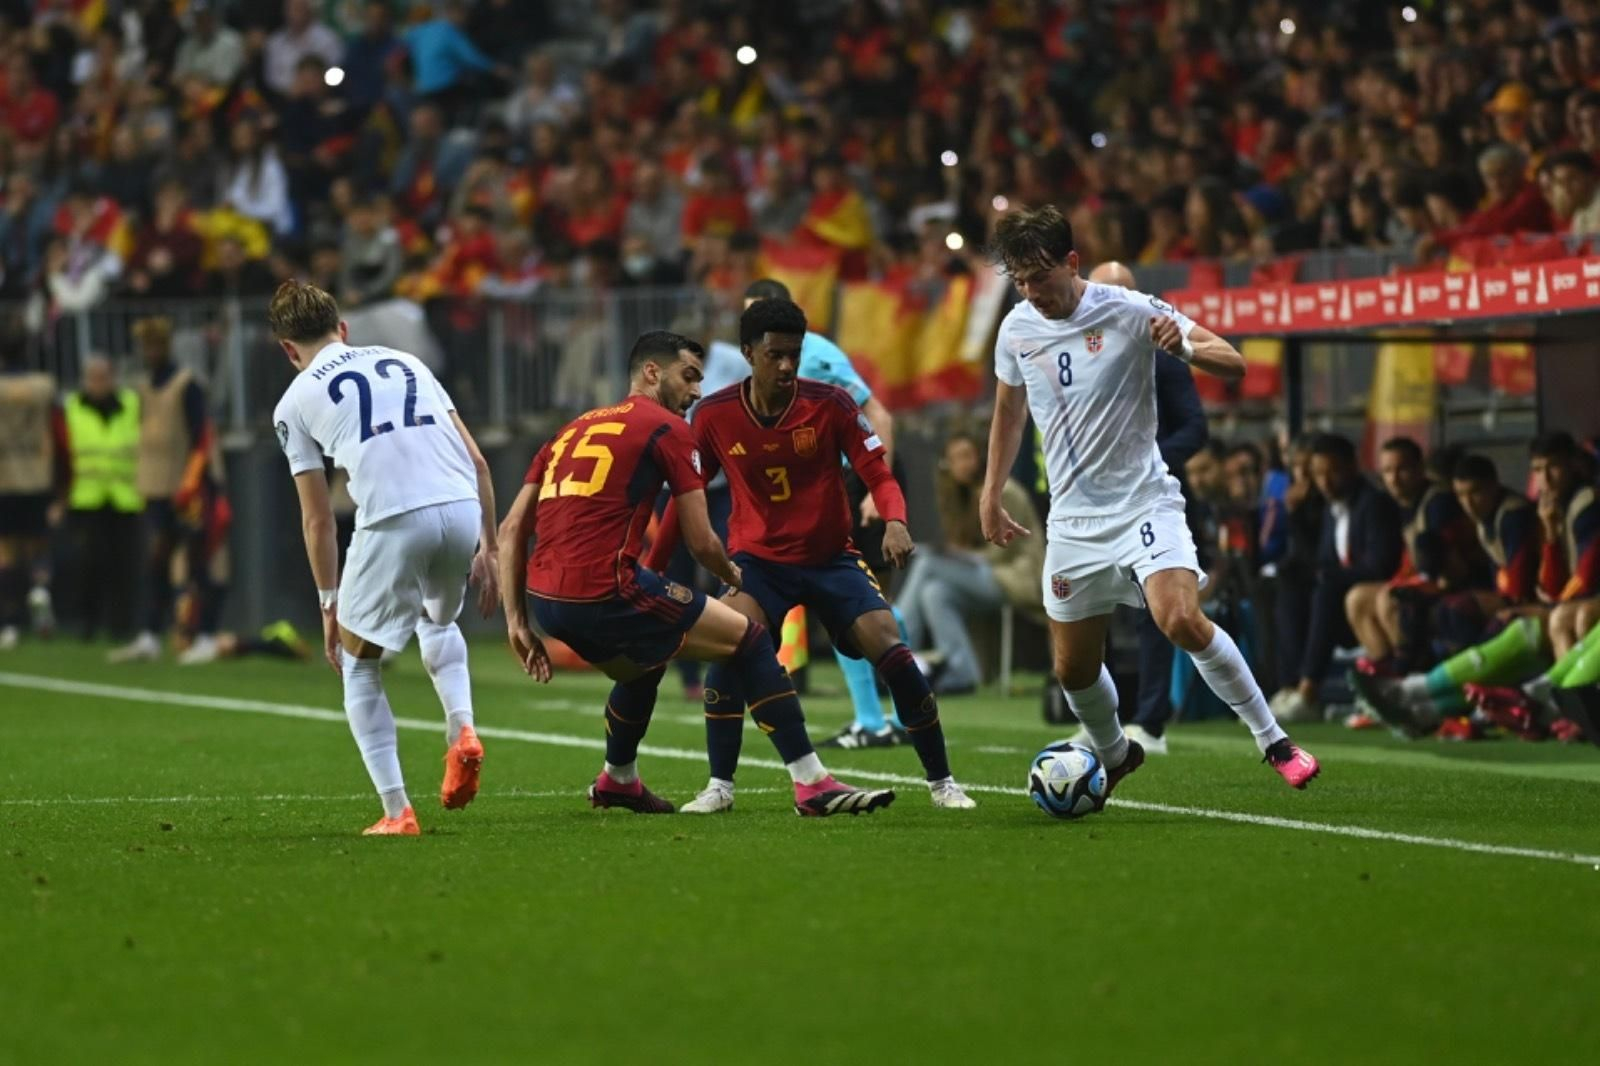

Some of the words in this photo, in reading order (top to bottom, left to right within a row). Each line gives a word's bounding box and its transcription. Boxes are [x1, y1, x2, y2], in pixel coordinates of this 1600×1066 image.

[1057, 351, 1073, 387] 8
[328, 359, 436, 443] 22
[537, 422, 627, 501] 15
[765, 466, 792, 502] 3
[1139, 521, 1156, 548] 8
